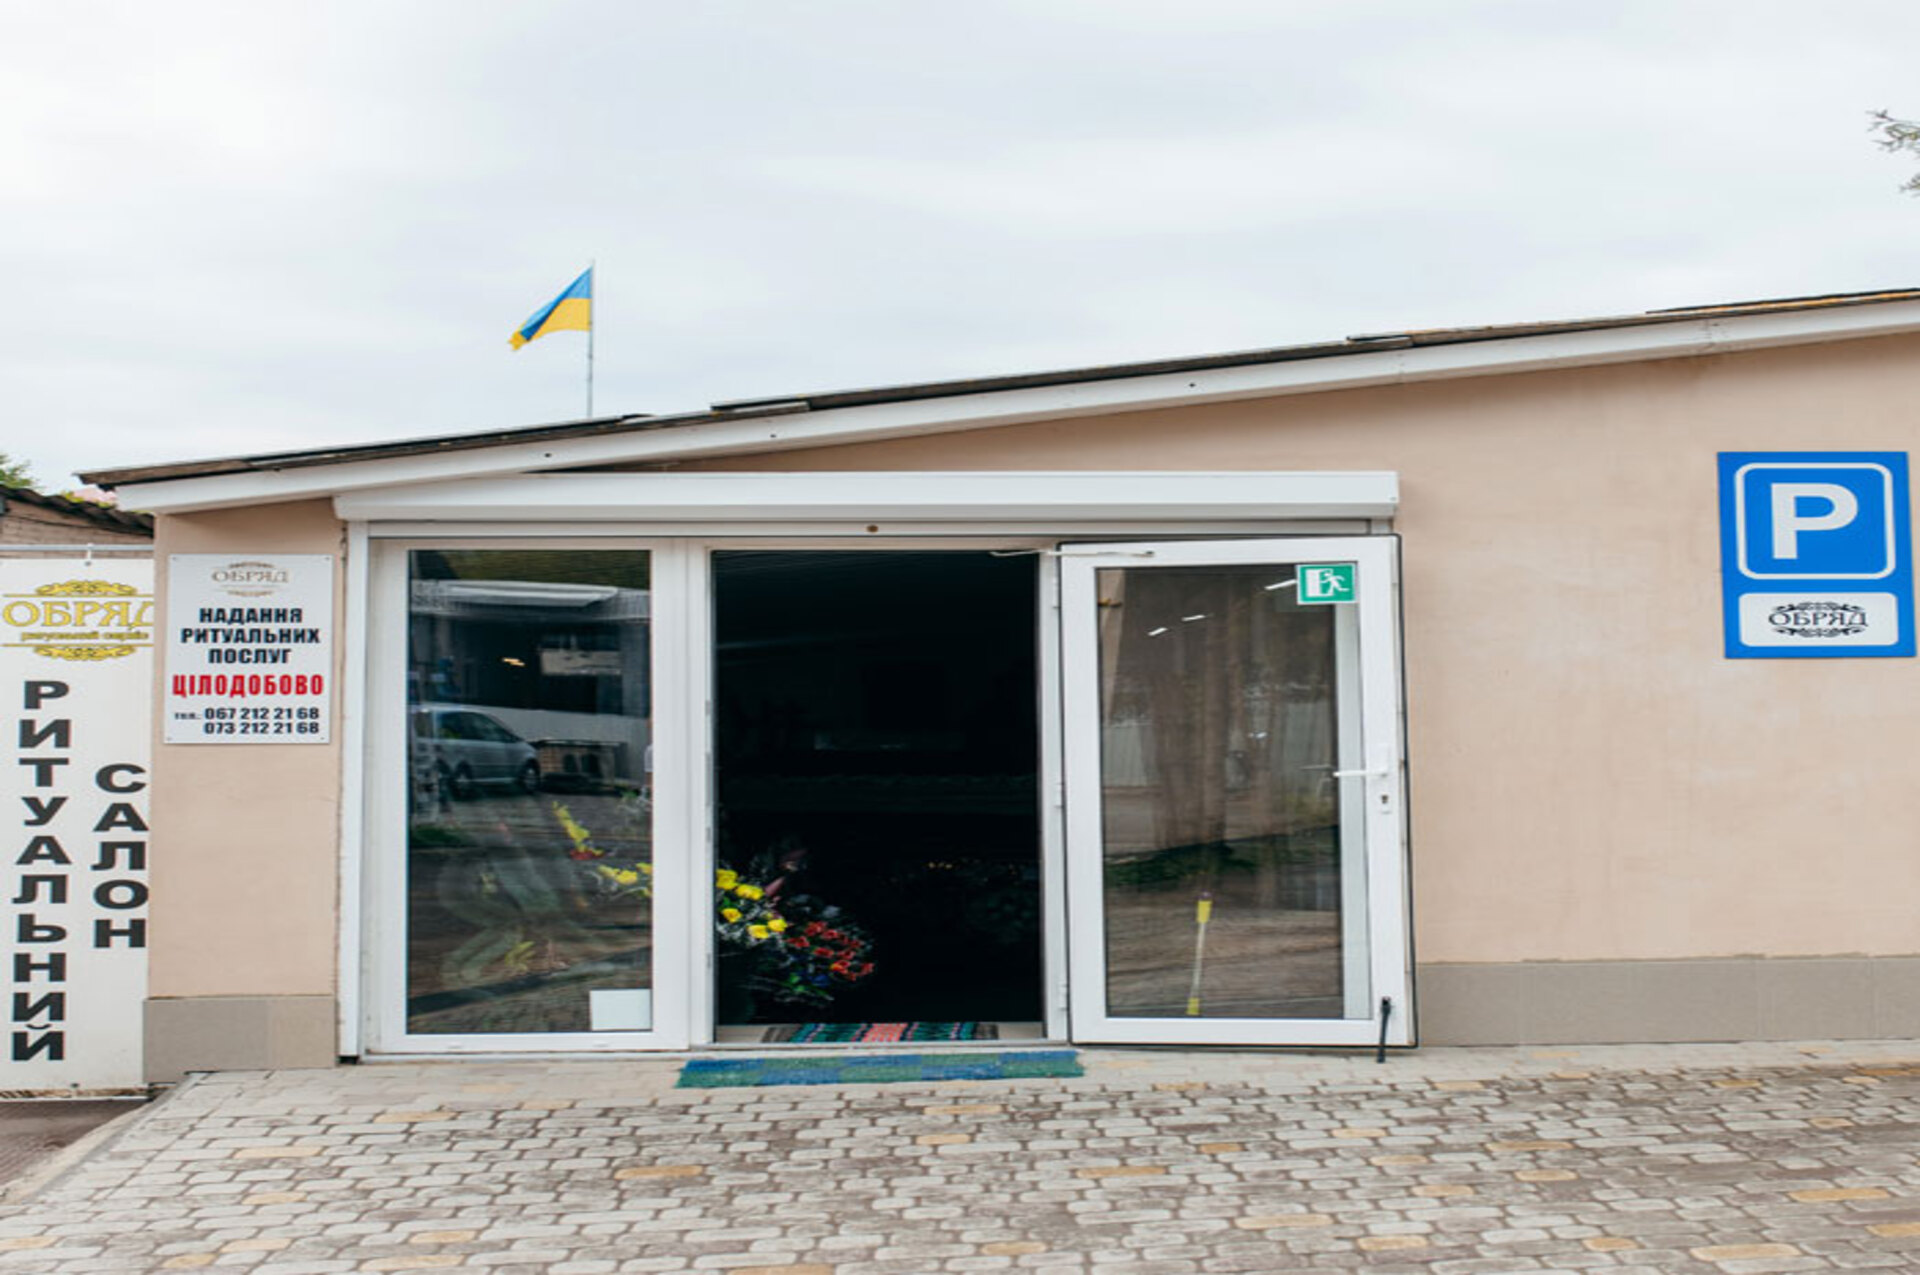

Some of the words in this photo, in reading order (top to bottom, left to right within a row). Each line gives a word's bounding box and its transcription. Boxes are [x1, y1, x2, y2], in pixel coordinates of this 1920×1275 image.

[1771, 483, 1858, 559] P
[199, 608, 302, 625] НАДАННЯ
[1768, 611, 1868, 627] ОБРЯД
[181, 628, 320, 643] РИТУАЛЬНИХ
[208, 648, 292, 663] ПОСЛУГ
[172, 674, 324, 698] ЦІЛОДОБОВО
[204, 707, 236, 720] 067
[240, 707, 270, 720] 212
[273, 707, 292, 720] 21
[296, 707, 319, 720] 68
[204, 722, 236, 734] 073
[240, 722, 270, 734] 212
[273, 722, 292, 734] 21
[296, 722, 319, 734] 68
[91, 763, 149, 948] САЛОН
[11, 680, 72, 1061] РИТУАЛЬНИЙ
